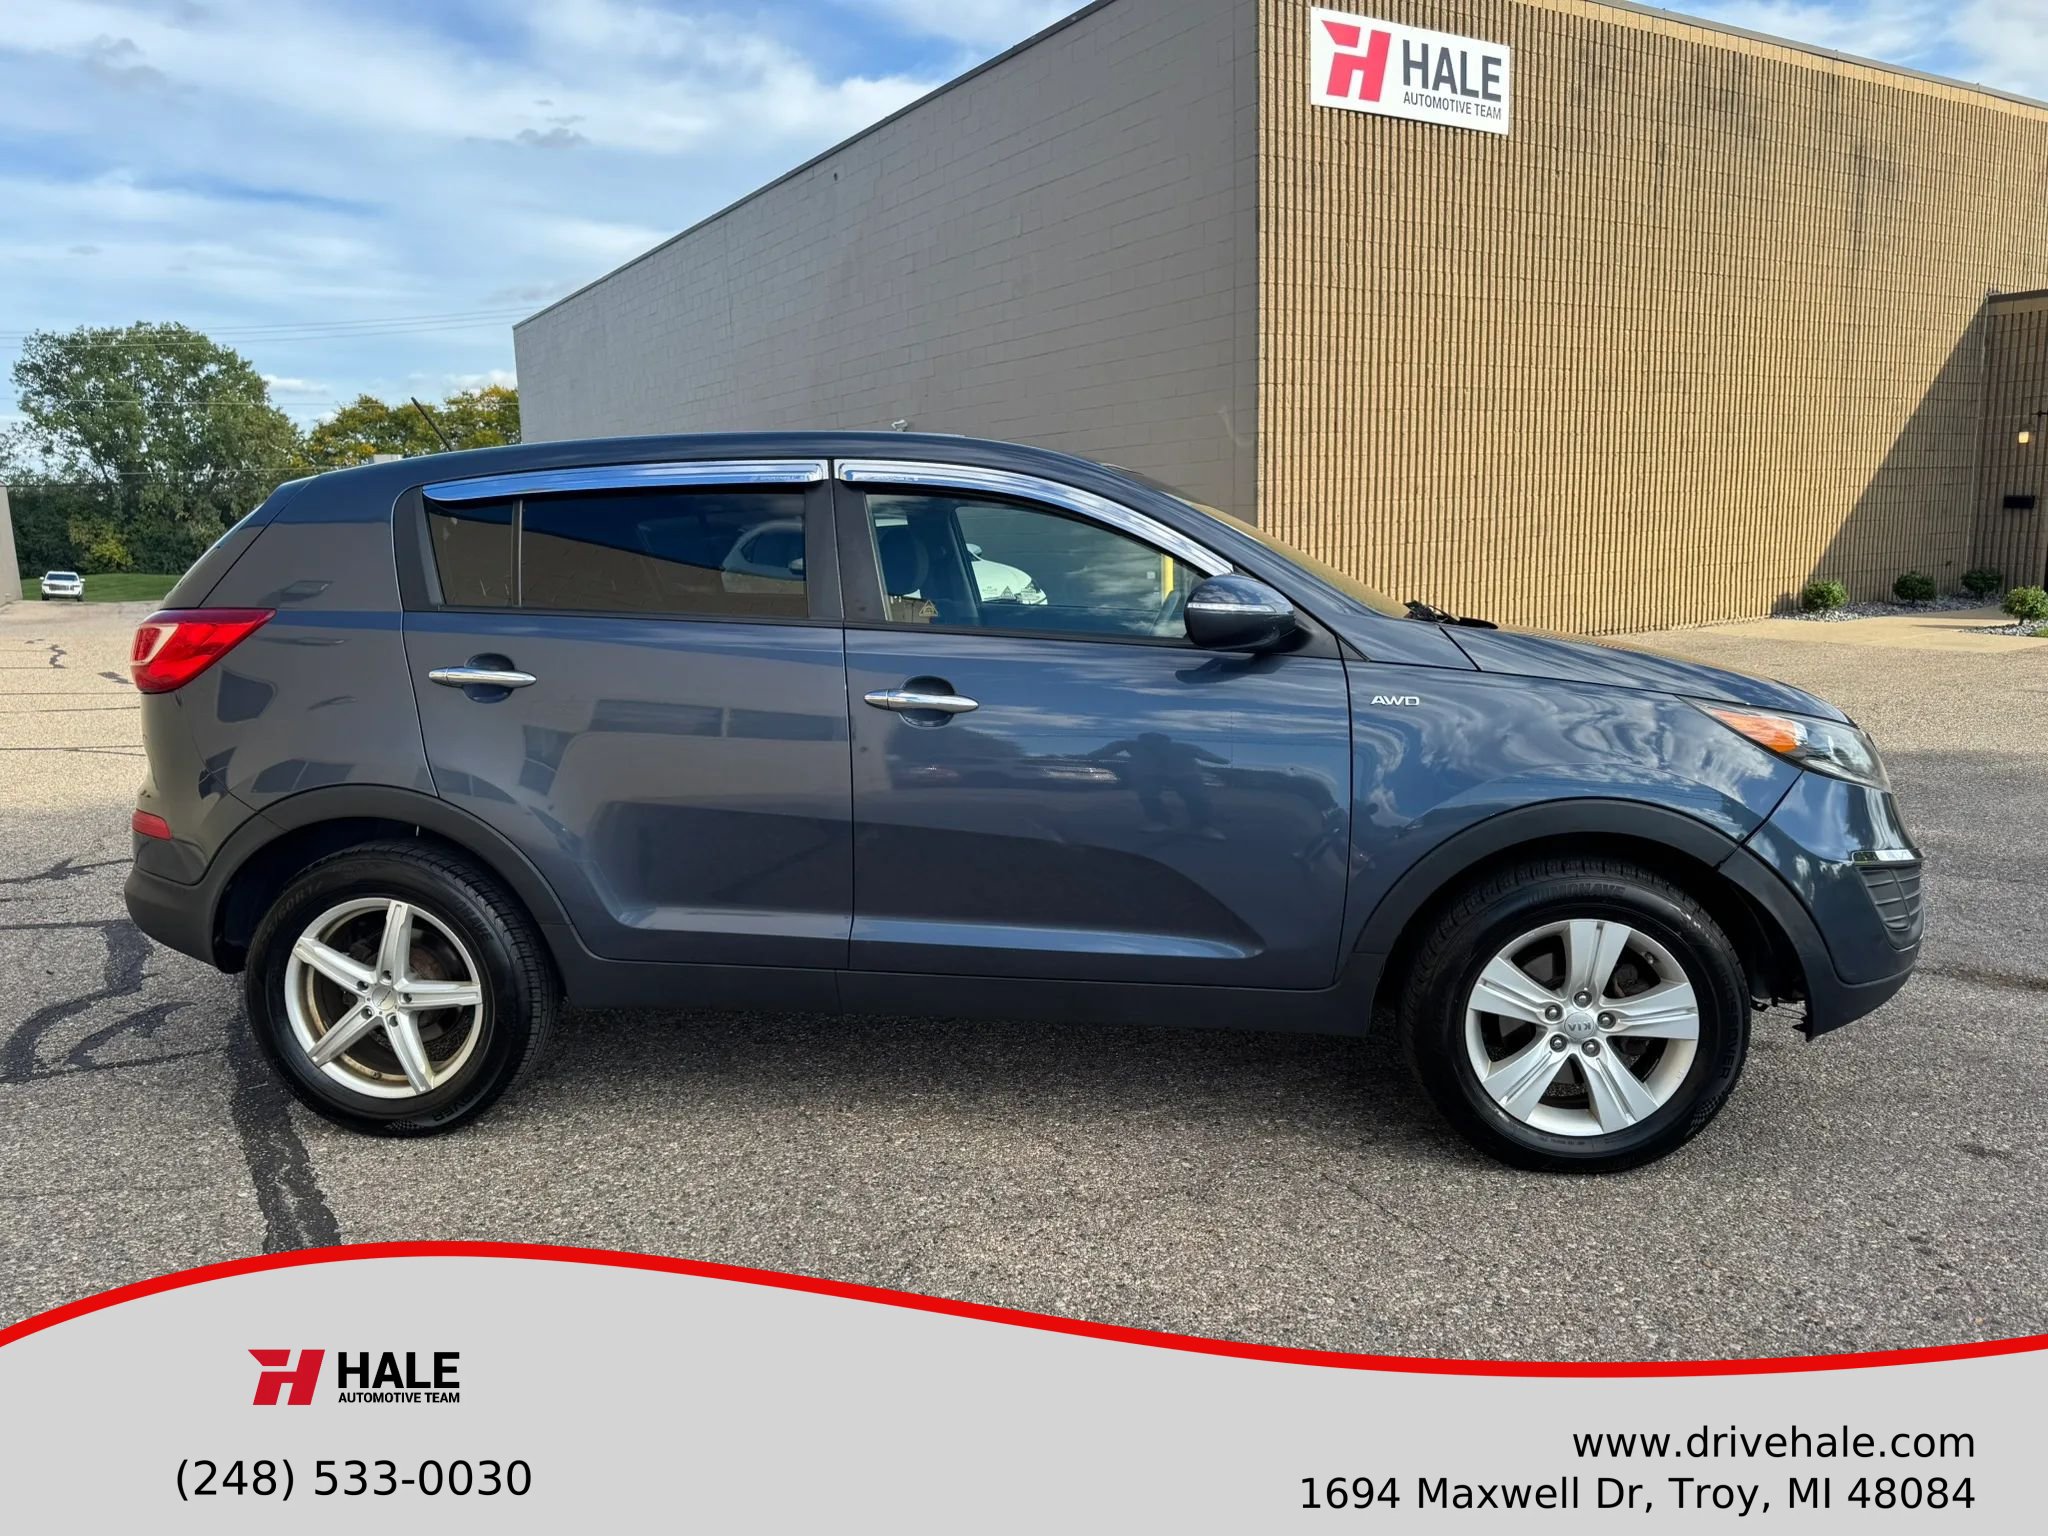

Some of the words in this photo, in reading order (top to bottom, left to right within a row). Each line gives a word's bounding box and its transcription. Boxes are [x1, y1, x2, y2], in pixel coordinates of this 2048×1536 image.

[1402, 39, 1502, 103] HALE
[1403, 91, 1472, 115] AUTOMOTIVE
[1474, 103, 1502, 120] TEAM
[1370, 695, 1420, 706] AWD
[1567, 1021, 1592, 1032] KIA
